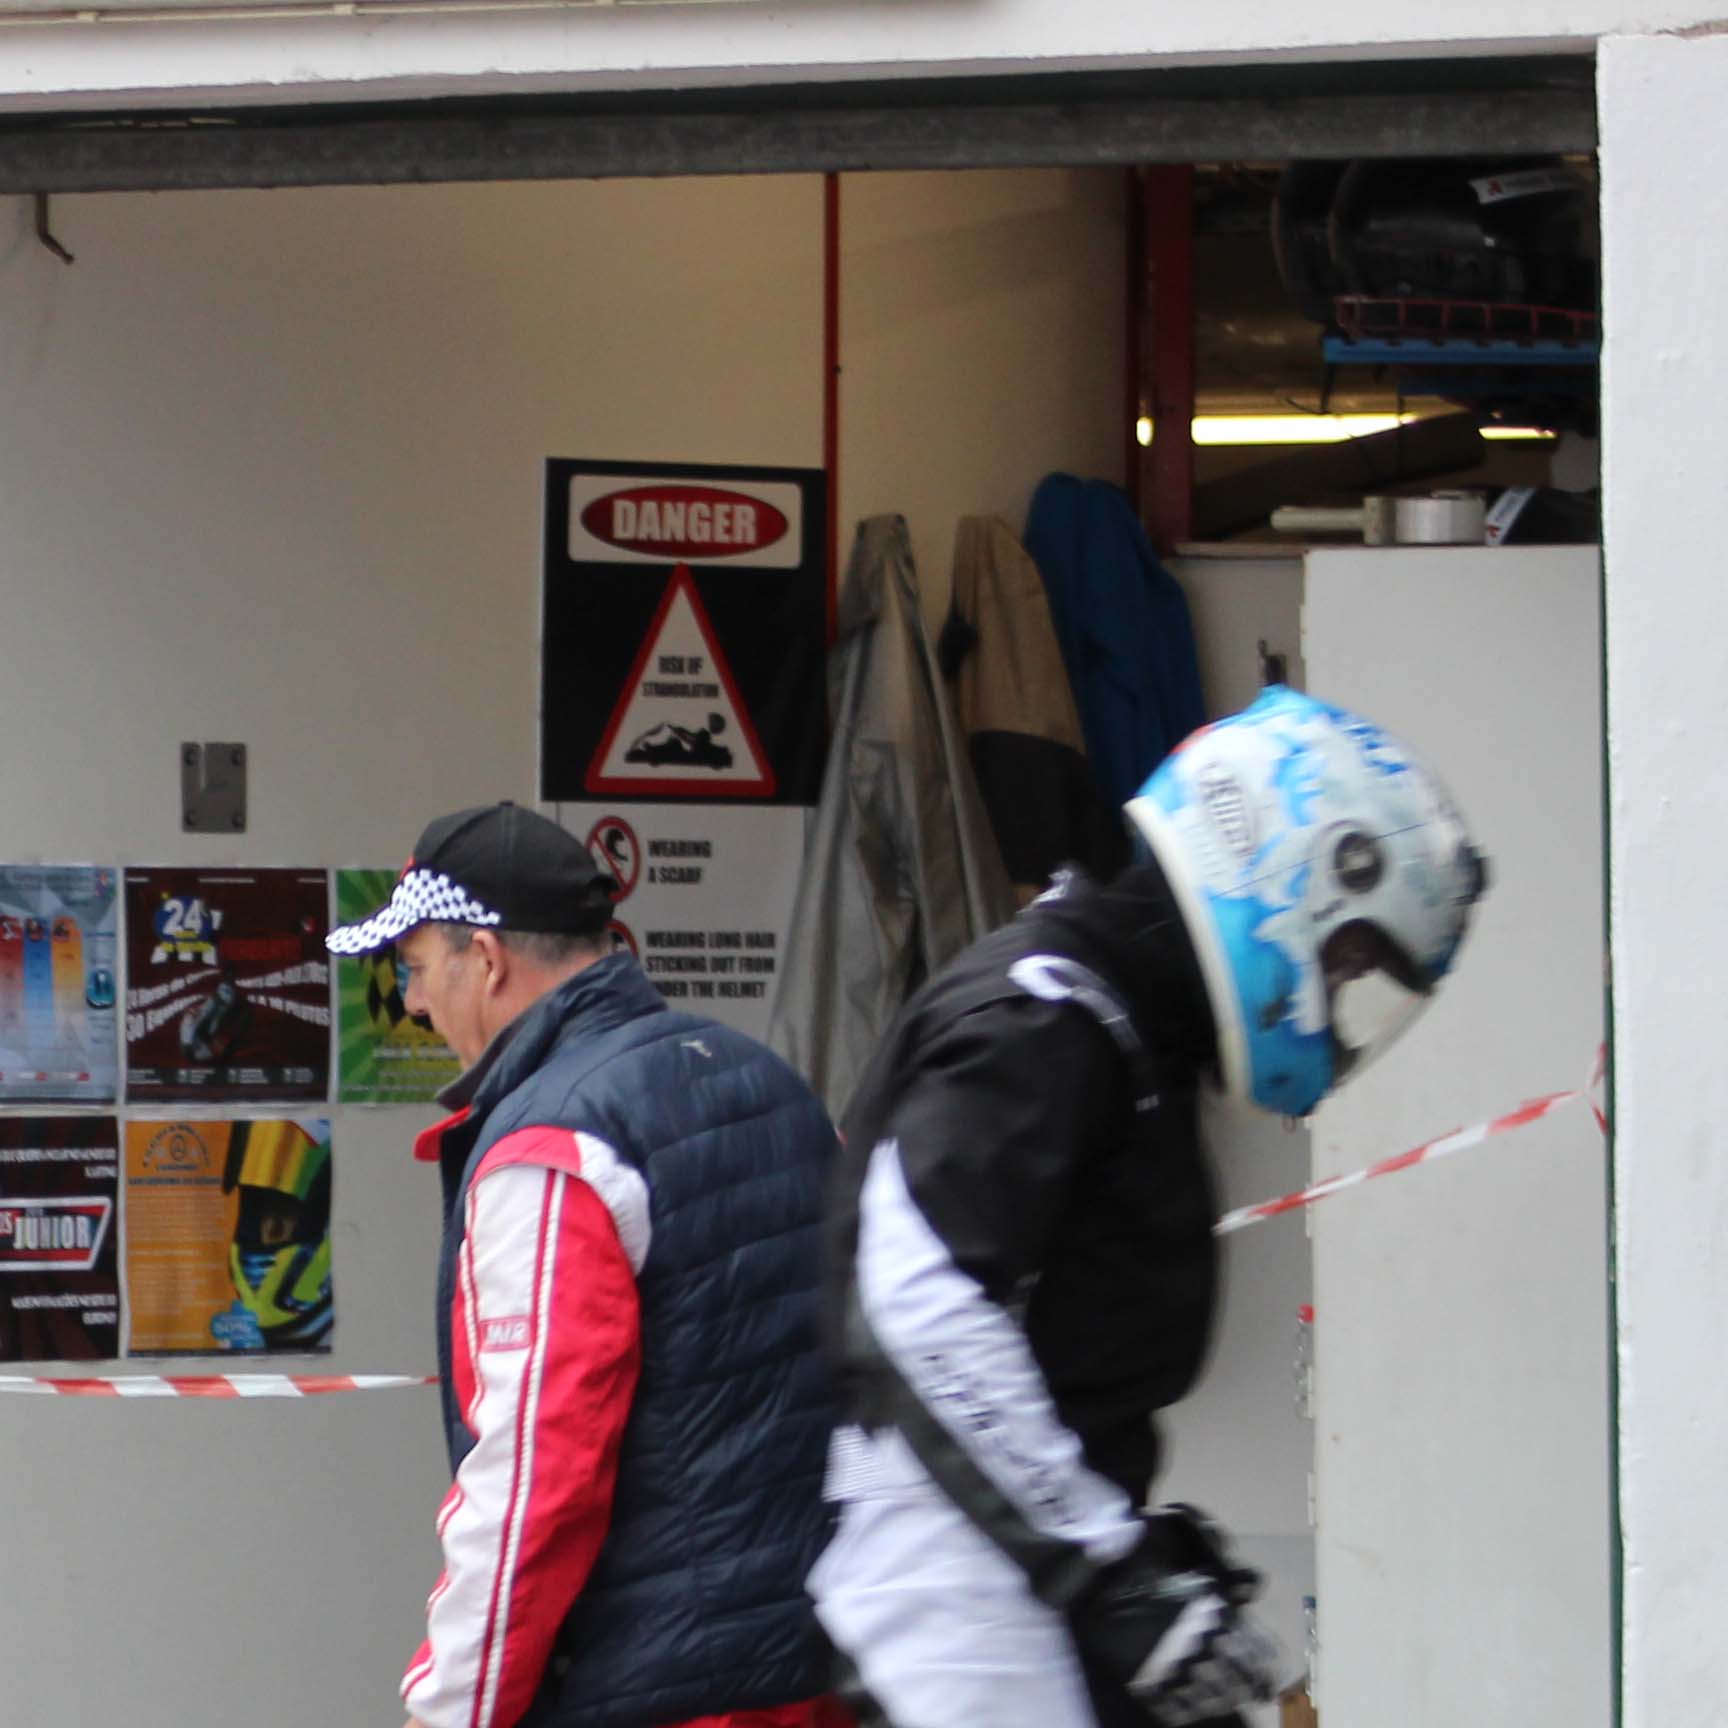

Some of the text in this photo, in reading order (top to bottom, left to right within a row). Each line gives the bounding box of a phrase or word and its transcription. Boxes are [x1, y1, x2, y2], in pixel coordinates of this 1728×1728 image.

[612, 499, 758, 545] DANGER
[647, 840, 712, 859] WEARING
[648, 867, 703, 884] A SCARF
[646, 931, 777, 949] WEARING LONG HAIR
[646, 956, 776, 973] STICKING OUT FROM
[651, 981, 688, 998] NDER
[691, 981, 715, 998] THE
[12, 1215, 92, 1250] JUNIOR
